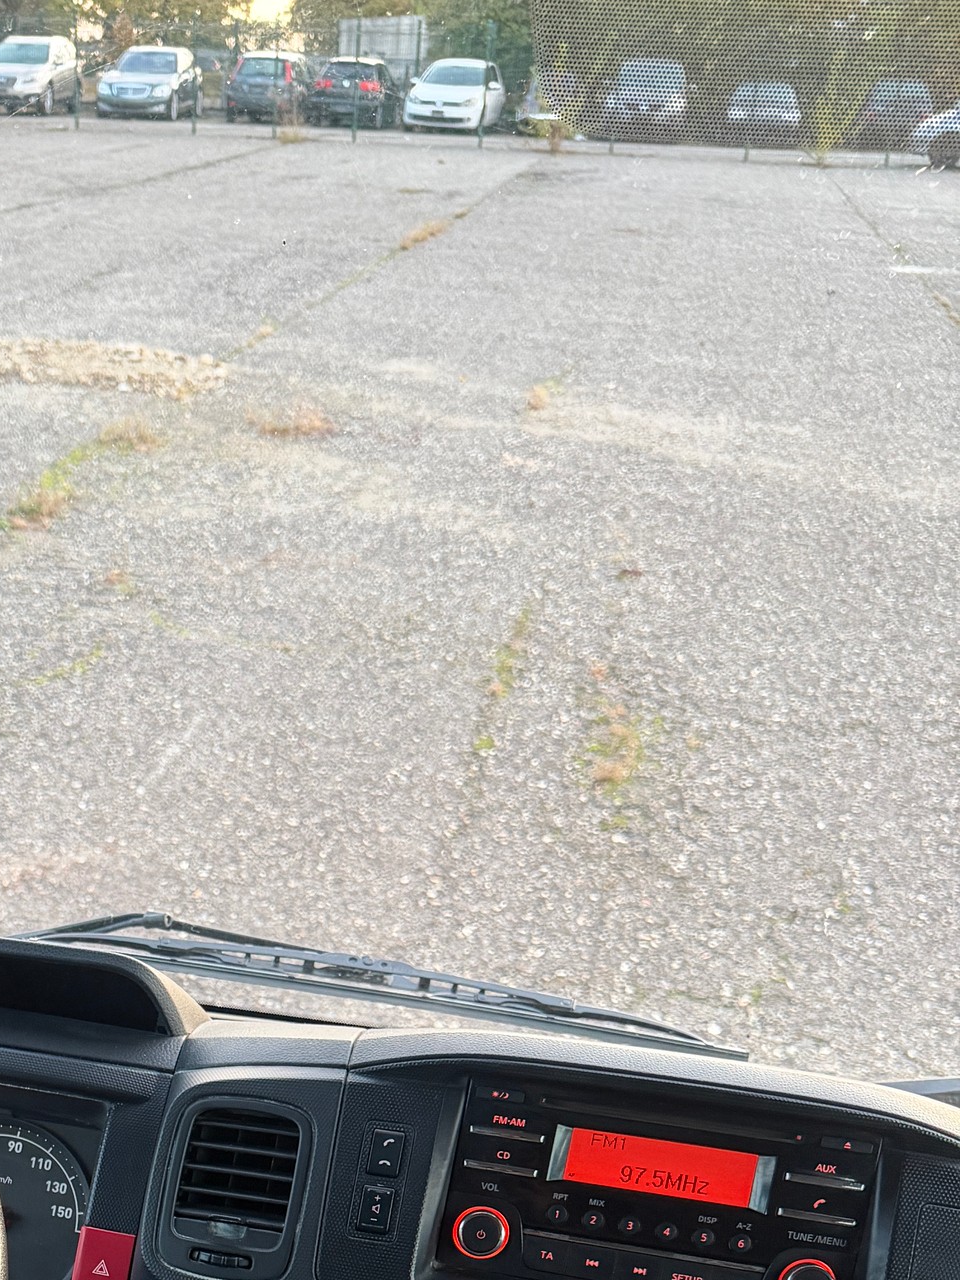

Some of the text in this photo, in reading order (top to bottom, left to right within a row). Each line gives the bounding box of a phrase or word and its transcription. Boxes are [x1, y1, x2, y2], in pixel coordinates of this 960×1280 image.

[590, 1133, 628, 1150] FM1
[7, 1140, 23, 1154] 90
[496, 1150, 511, 1160] CD
[30, 1156, 52, 1171] 110
[814, 1163, 837, 1174] AUX
[619, 1165, 711, 1196] 97.5MHz
[45, 1180, 68, 1195] 130
[481, 1182, 500, 1192] VOL
[552, 1192, 569, 1201] RPT
[588, 1198, 605, 1208] MIX
[50, 1204, 73, 1220] 150
[554, 1209, 560, 1219] 1
[589, 1215, 597, 1225] 2
[698, 1215, 717, 1224] DISP
[626, 1221, 634, 1230] 3
[736, 1222, 753, 1231] A-Z
[663, 1227, 670, 1236] 4
[700, 1233, 708, 1242] 5
[787, 1230, 848, 1248] TUNE/MENU
[737, 1239, 745, 1248] 6
[540, 1250, 554, 1261] TA
